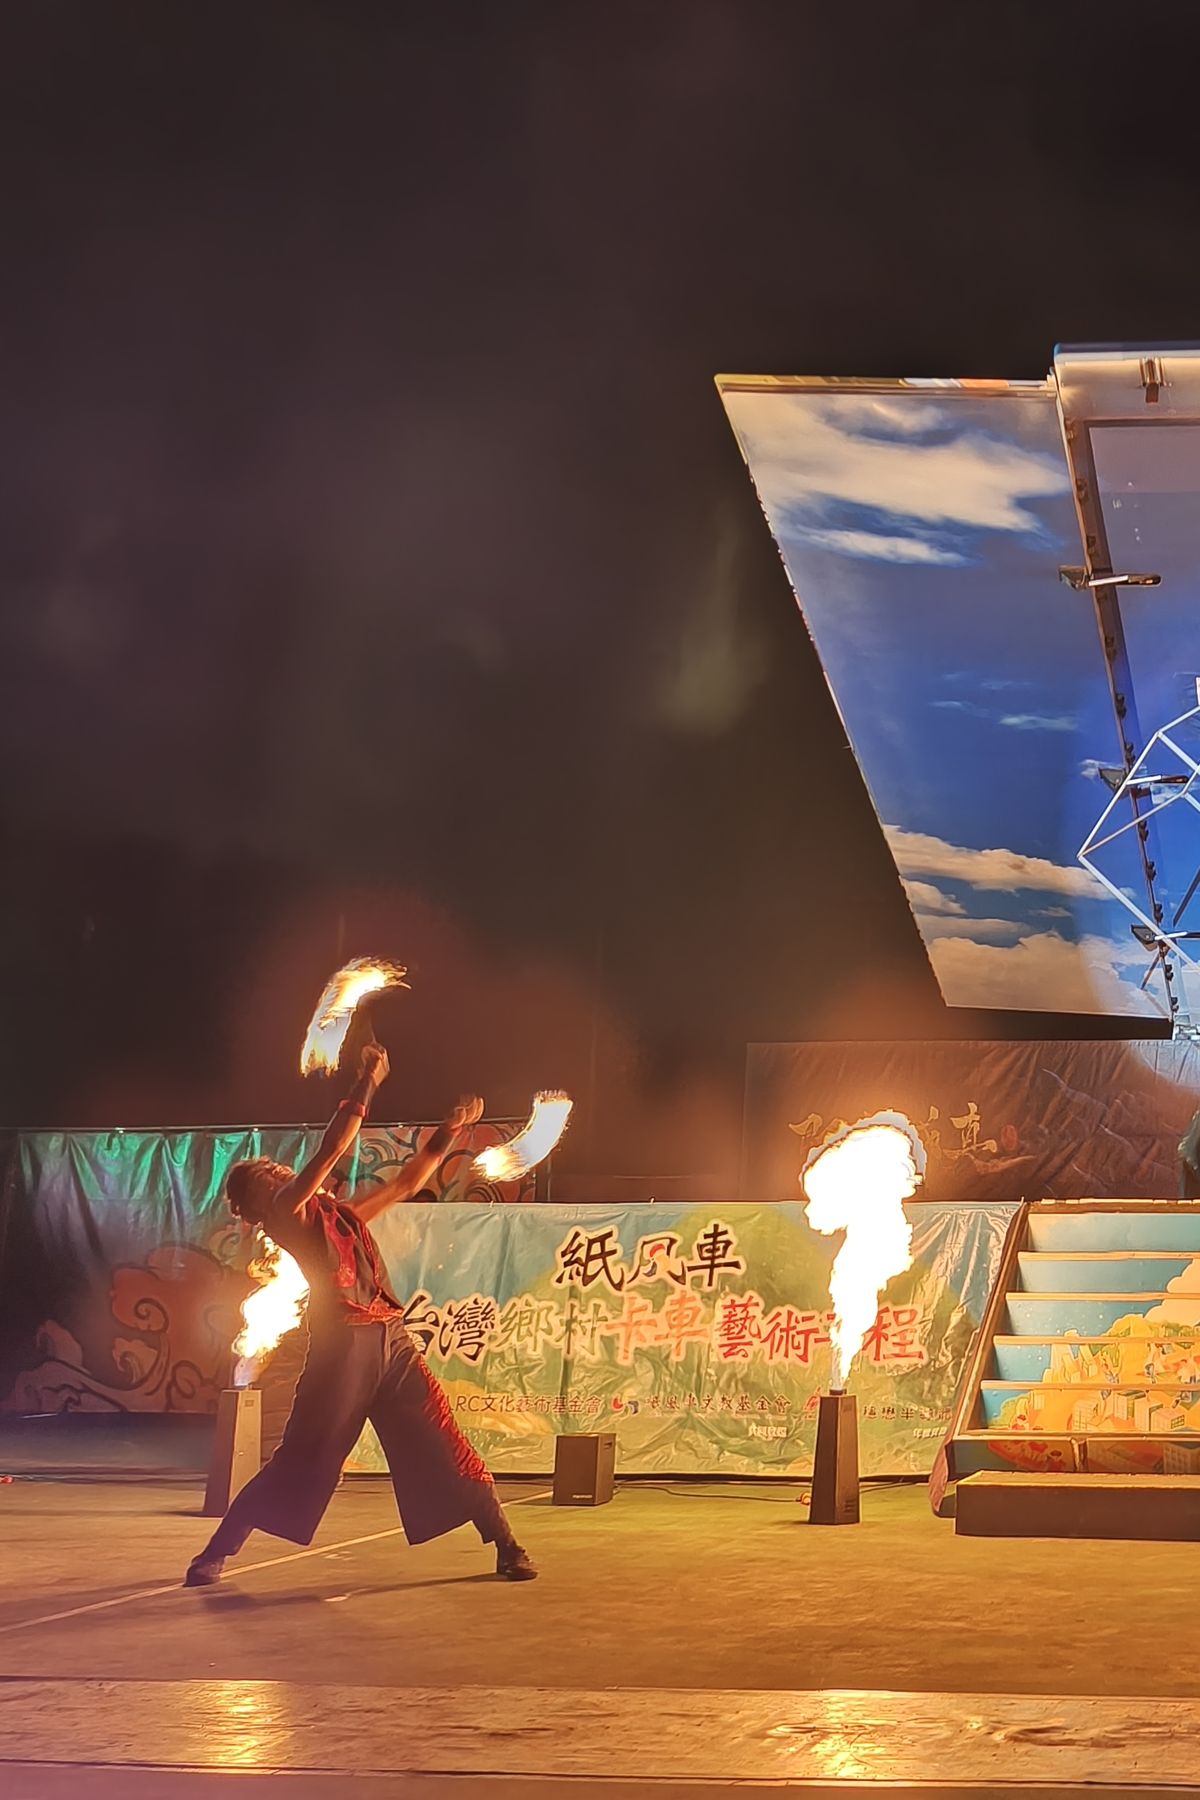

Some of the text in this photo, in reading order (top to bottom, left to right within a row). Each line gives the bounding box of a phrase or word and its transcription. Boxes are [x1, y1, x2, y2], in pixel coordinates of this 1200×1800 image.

[555, 1223, 742, 1291] 紙風車
[402, 1291, 924, 1362] 台灣鄉村卡車藝術程
